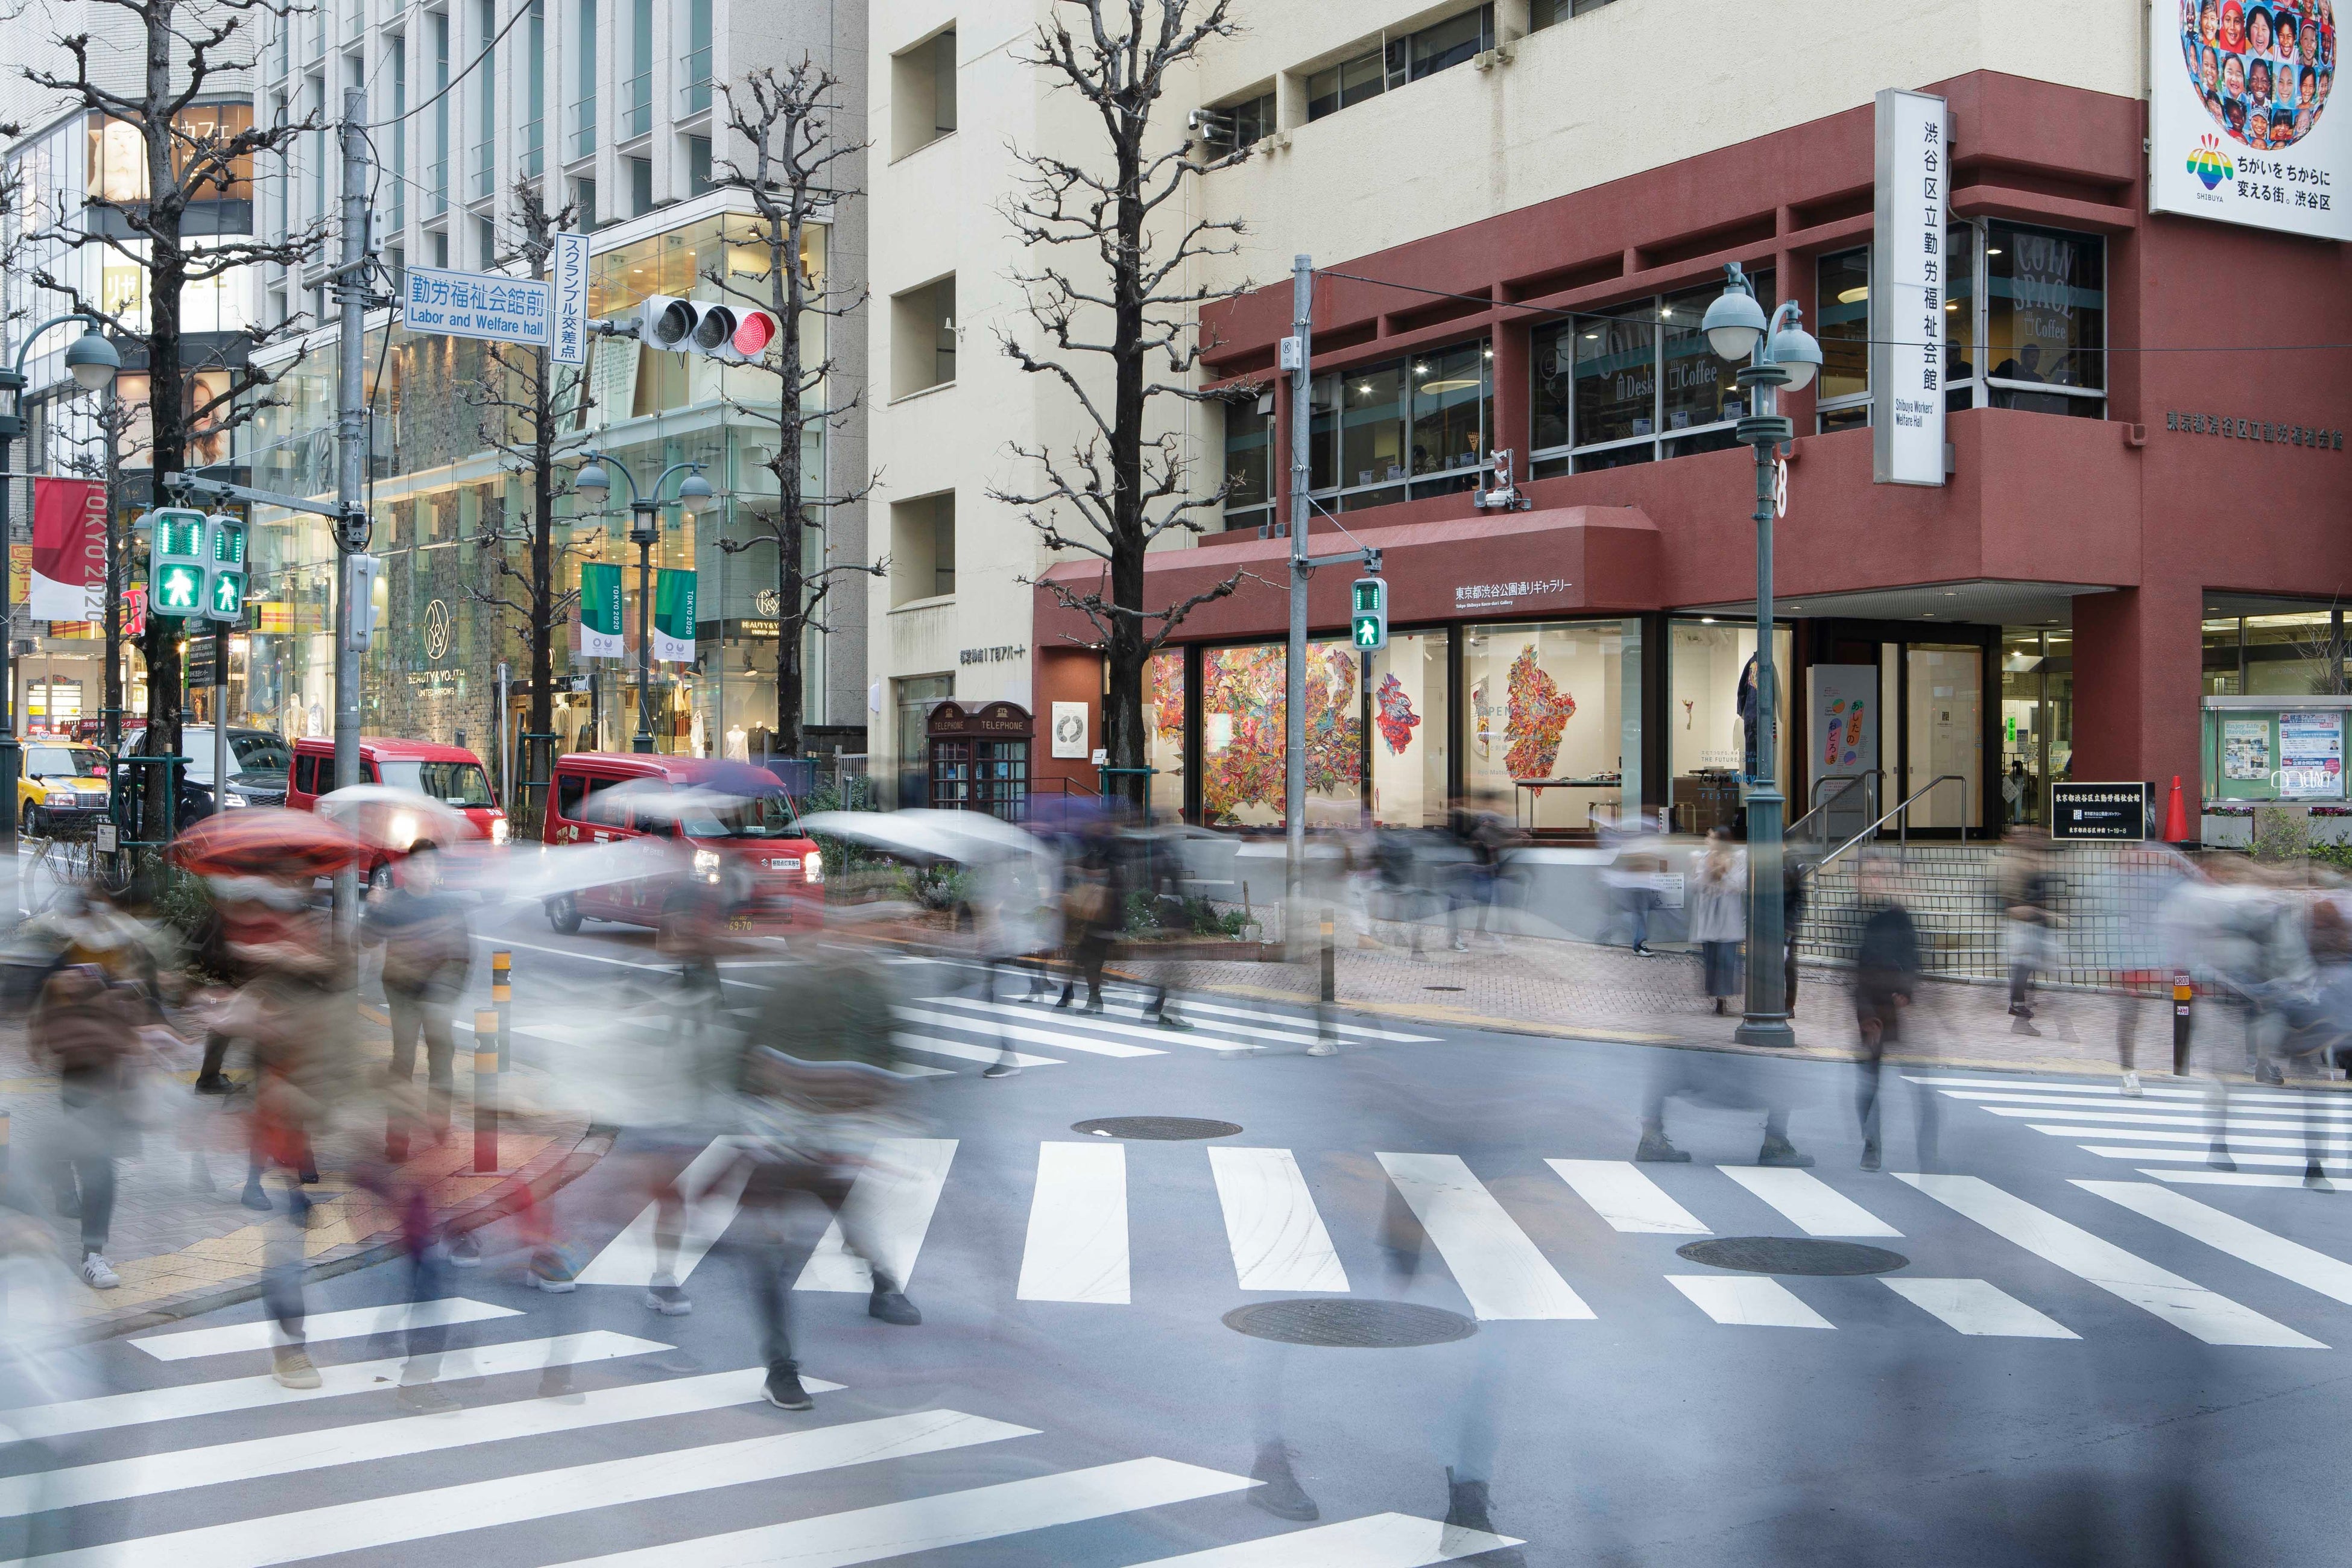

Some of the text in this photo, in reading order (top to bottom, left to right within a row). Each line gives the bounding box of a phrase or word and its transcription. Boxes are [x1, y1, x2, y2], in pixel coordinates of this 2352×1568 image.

[170, 121, 230, 145] カフェ
[2237, 156, 2330, 186] ちがいを ちからに
[2196, 193, 2224, 203] SHIBUYA
[1923, 122, 1938, 391] 渋谷区立勤労福祉会館
[411, 276, 545, 317] 勤労福祉会館前
[560, 239, 580, 359] スクランブル交差点
[411, 307, 543, 335] Labor and Welfare hall
[2035, 317, 2067, 339] Coffee
[1626, 360, 1718, 399] Desk Coffee
[1895, 399, 1914, 413] Shibuya
[1895, 413, 1923, 428] Welfare Hall
[2167, 410, 2343, 450] 東京都渋谷区立勤労福祉会館
[84, 484, 107, 622] TOKYO 2020
[1455, 579, 1572, 601] 東京都渋谷公園通りギャラリー
[418, 687, 455, 697] UNITED ARROWS
[1478, 706, 1513, 716] OPEN
[935, 721, 964, 730] TELEPHONE
[981, 721, 1023, 730] TELEPHONE
[1698, 769, 1757, 790] Tokyo Toky
[2055, 794, 2140, 803] 東京都渋谷区立勤労福祉会館
[729, 921, 752, 931] 69-70
[2175, 976, 2189, 985] CROD
